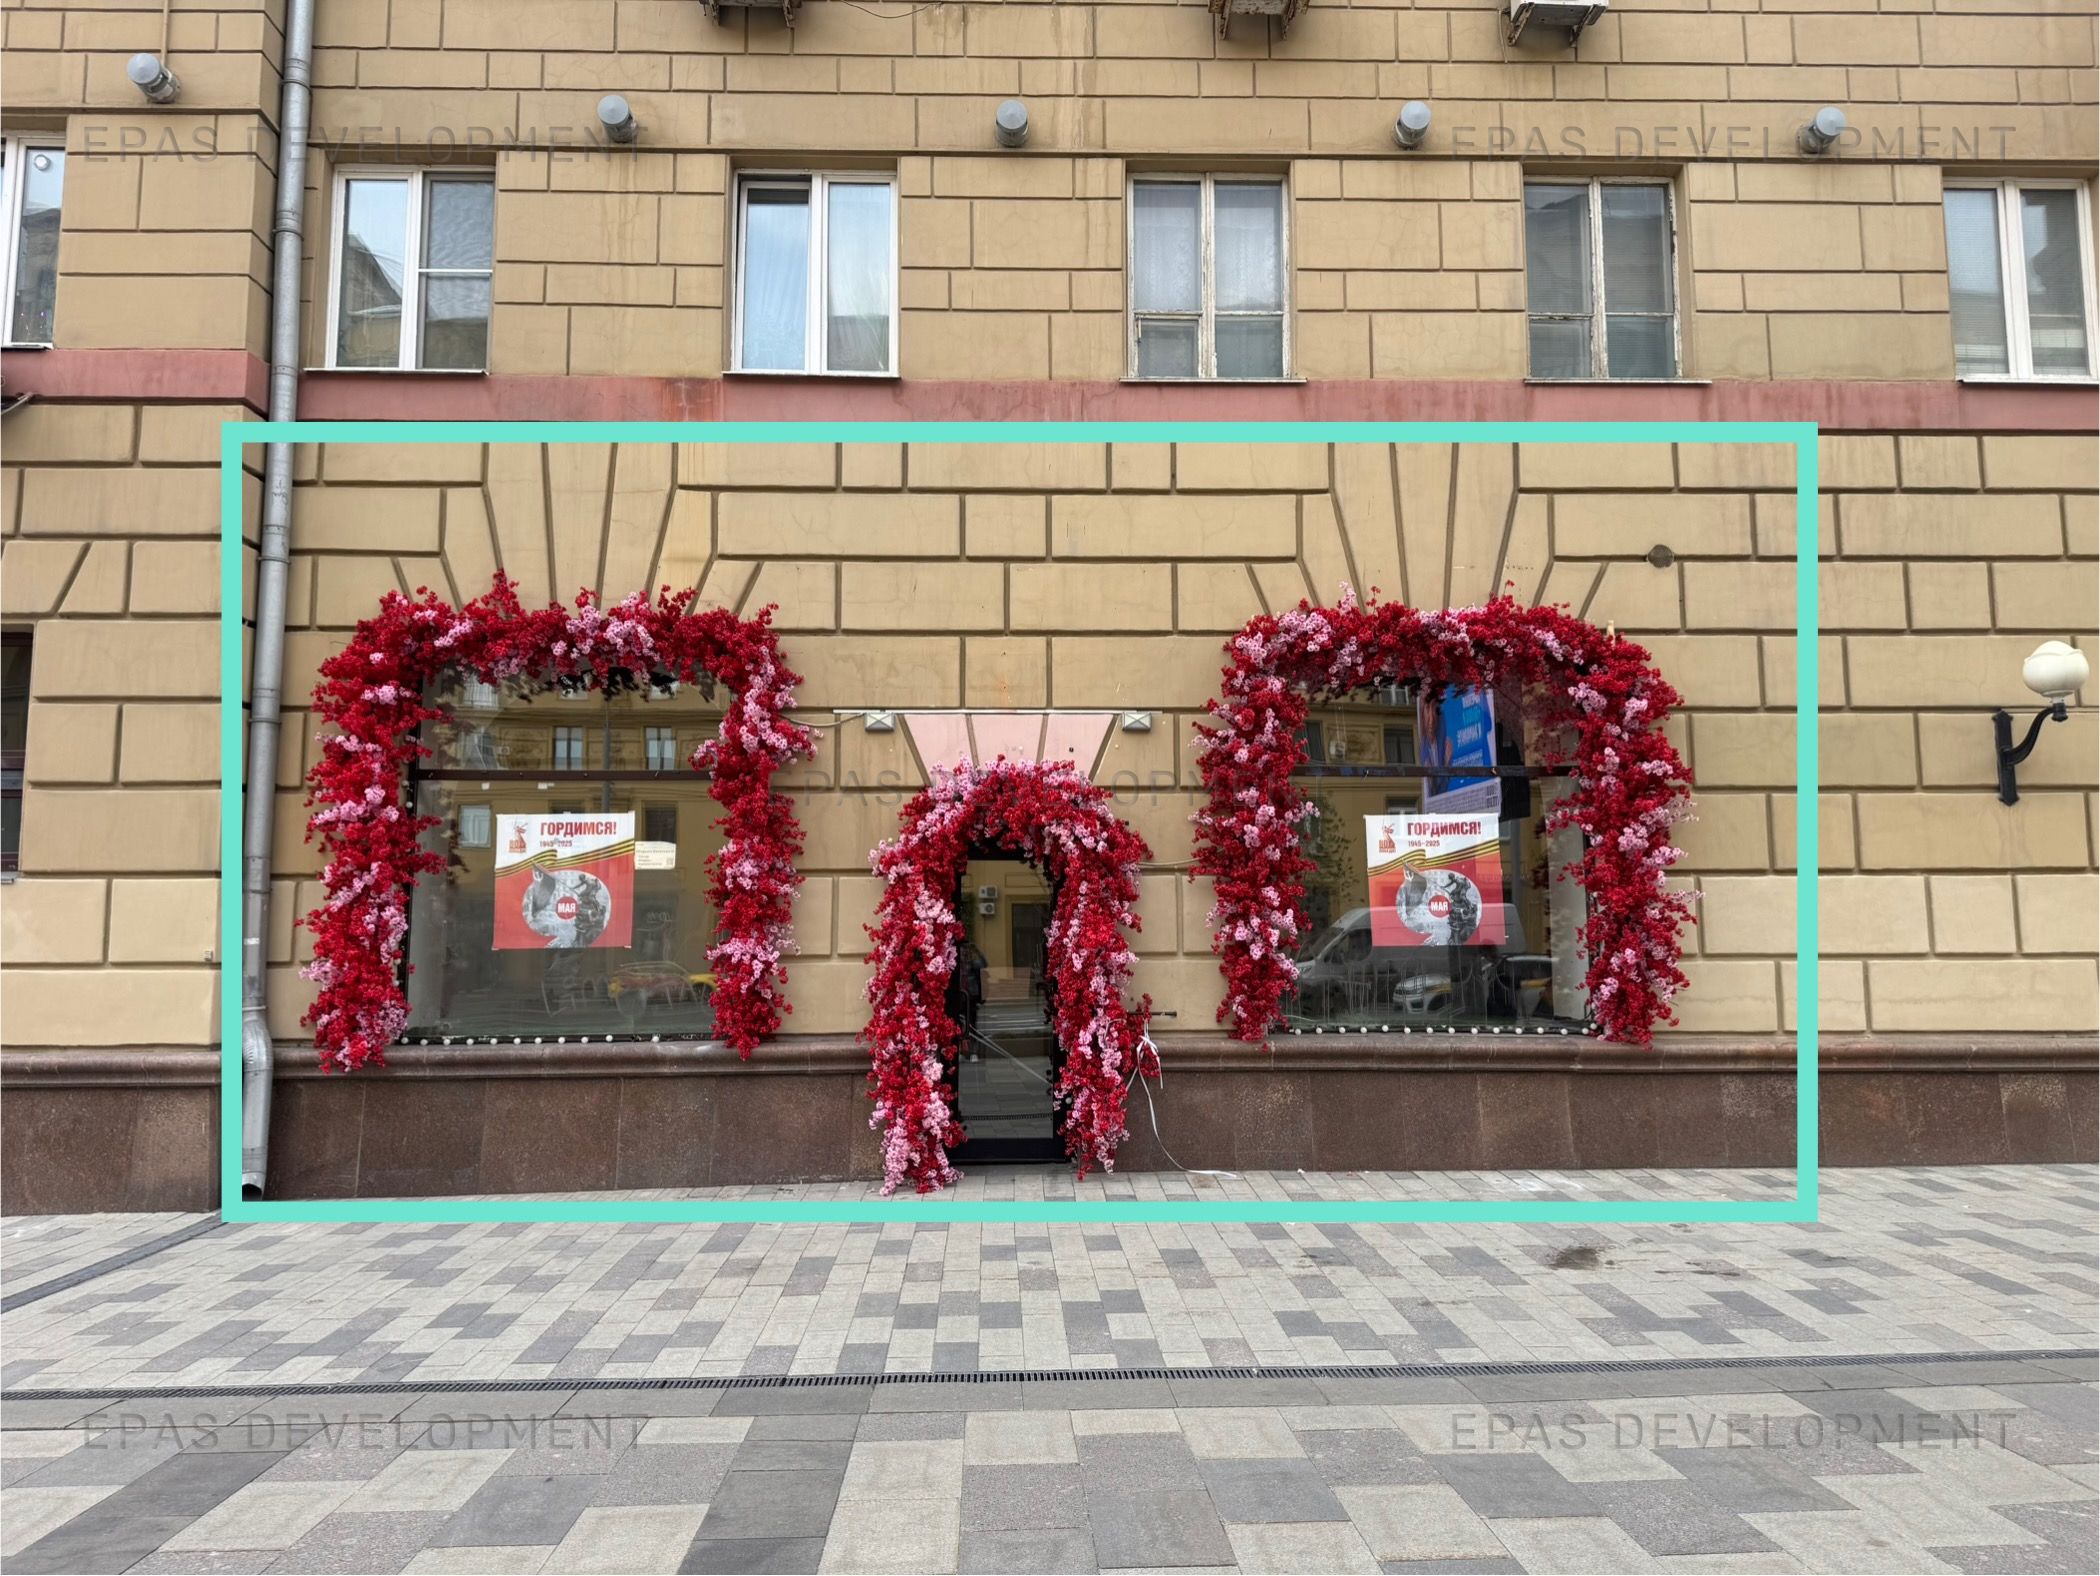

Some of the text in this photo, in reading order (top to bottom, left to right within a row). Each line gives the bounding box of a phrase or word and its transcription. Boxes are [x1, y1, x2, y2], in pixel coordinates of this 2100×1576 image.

[540, 822, 617, 837] ГОРДИМСЯ!
[1407, 821, 1482, 838] ГОРДИМСЯ!
[557, 902, 576, 914] МАЯ
[1430, 901, 1449, 912] МАЯ
